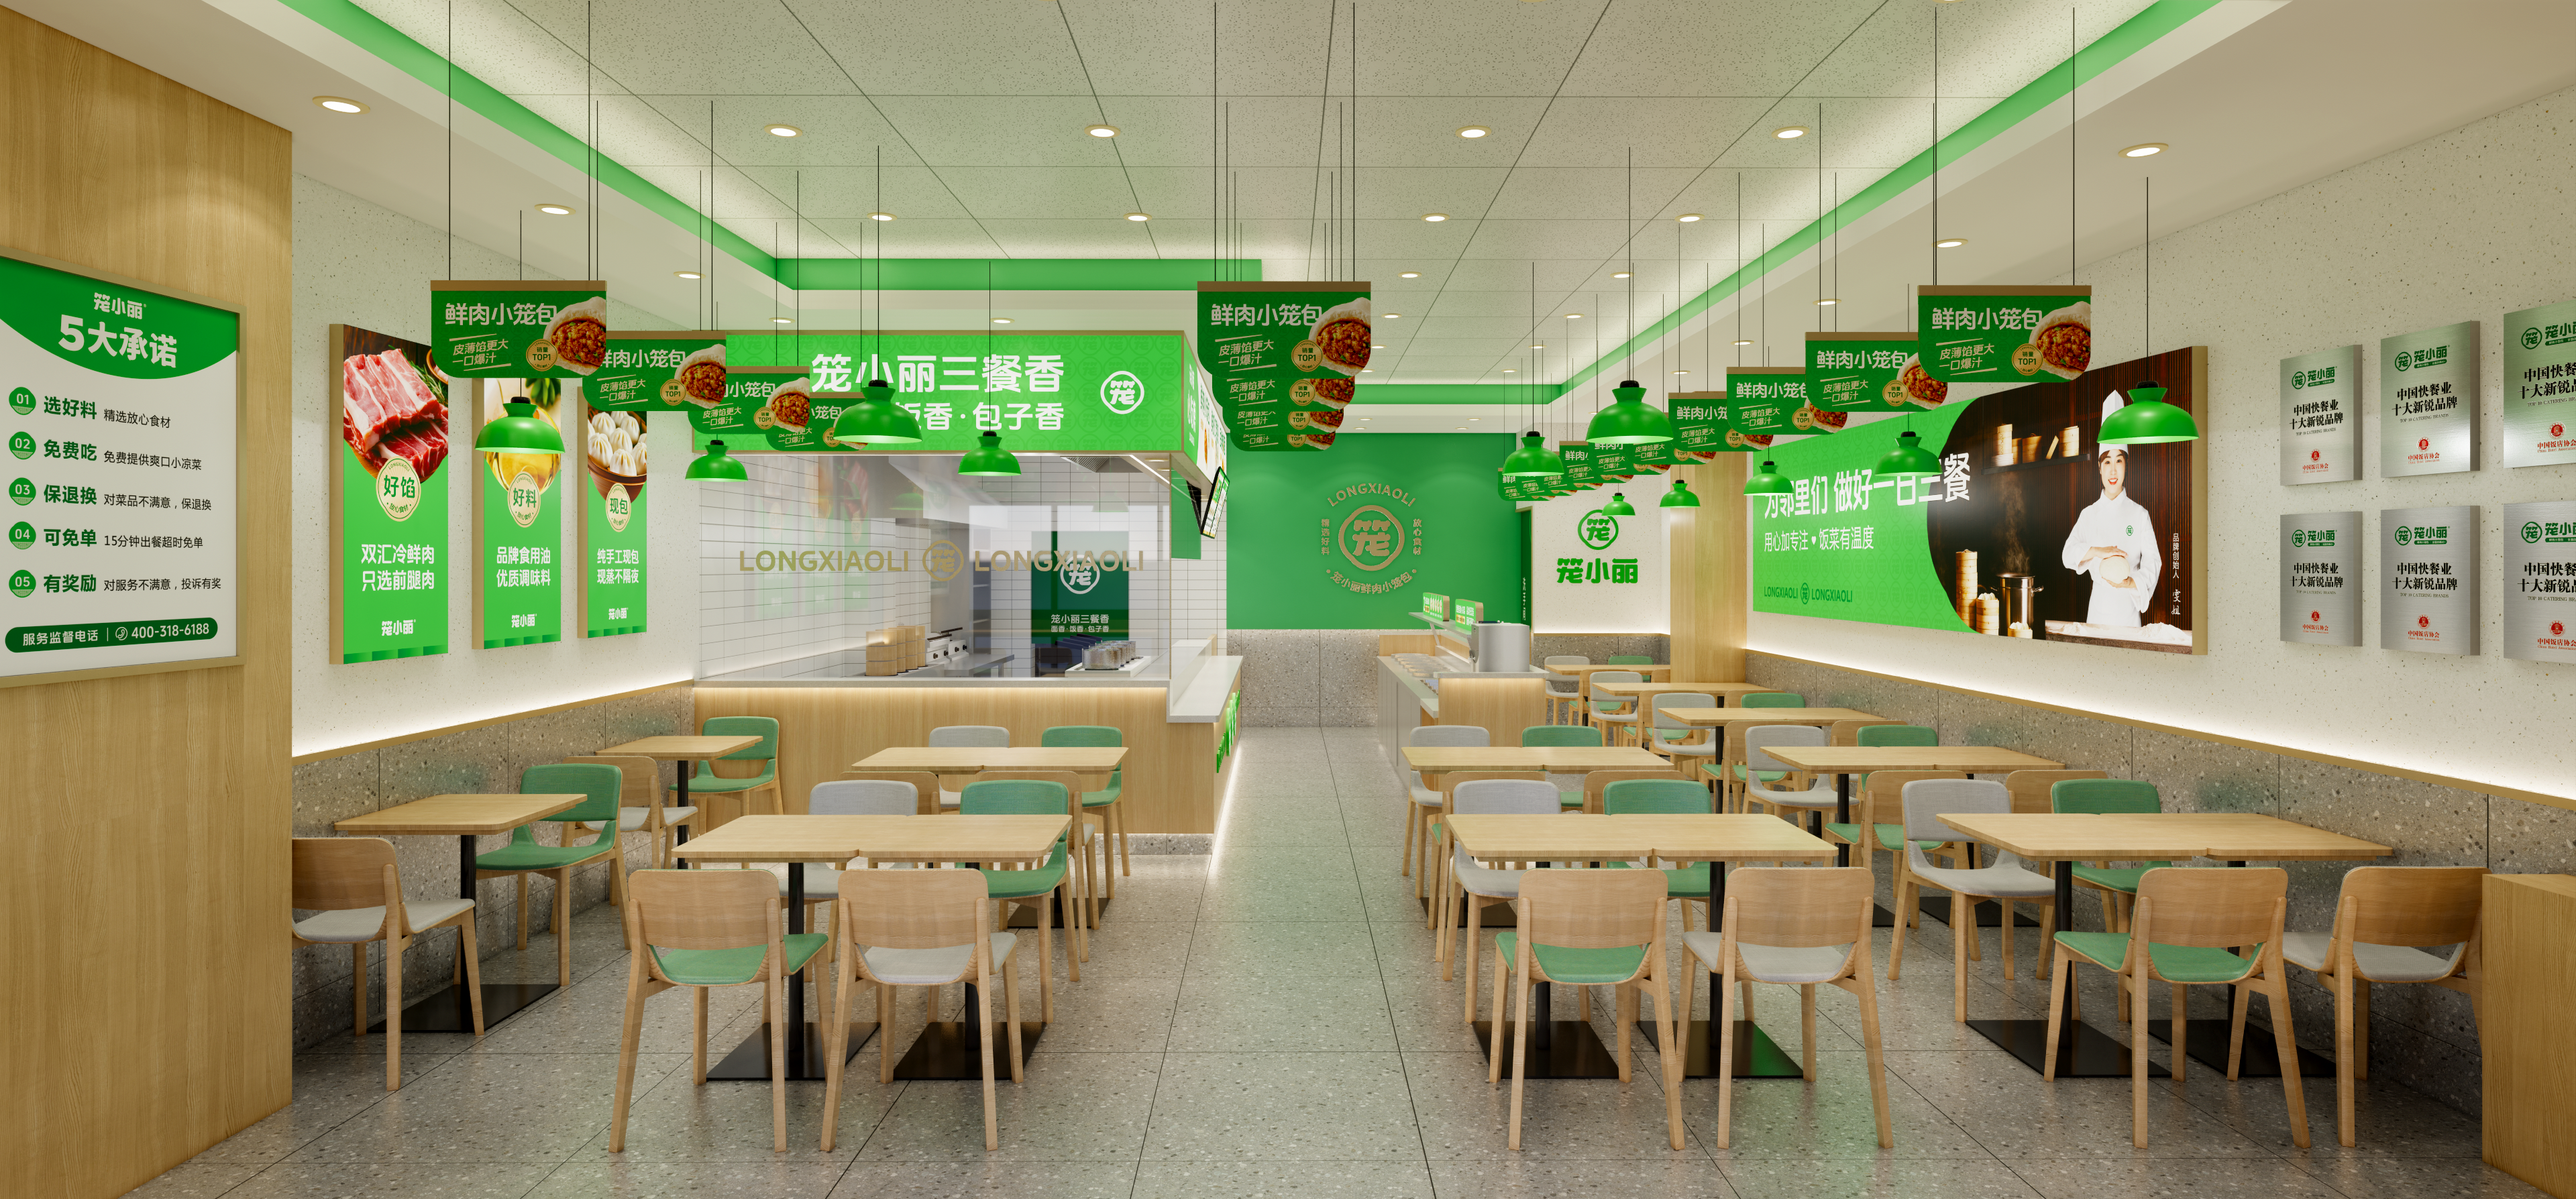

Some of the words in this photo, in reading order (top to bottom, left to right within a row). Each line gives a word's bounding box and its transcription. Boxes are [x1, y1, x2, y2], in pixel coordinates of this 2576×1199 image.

[94, 293, 143, 320] 笼小丽
[445, 302, 557, 326] 鲜肉小笼包
[1211, 304, 1322, 327] 鲜肉小笼包
[1932, 307, 2042, 330] 鲜肉小笼包
[2545, 321, 2576, 339] 笼小
[58, 315, 177, 368] 5大承诺
[453, 338, 508, 356] 皮薄馅更大
[1219, 339, 1275, 356] 皮薄馅更大
[1817, 350, 1909, 369] 鲜肉小笼包
[1939, 343, 1994, 360] 皮薄馅更大
[2414, 345, 2447, 363] 笼小丽
[452, 353, 496, 367] 一口爆汁
[1218, 353, 1262, 367] 一口爆汁
[1939, 357, 1983, 370] 一口爆汁
[811, 354, 1064, 393] 笼小丽三餐香
[2308, 367, 2335, 382] 笼小丽
[600, 379, 646, 393] 皮薄馅更大
[1230, 380, 1275, 393] 皮薄馅更大
[1823, 380, 1869, 394] 皮薄馅更大
[2397, 382, 2452, 401] 中国快餐业
[16, 393, 30, 405] 01
[600, 390, 635, 402] 一口爆汁
[1230, 391, 1265, 402] 一口爆汁
[1823, 390, 1859, 402] 一口爆汁
[44, 396, 97, 419] 选好料
[103, 408, 171, 429] 精选放心食材
[703, 406, 741, 418] 皮薄馅更大
[1741, 407, 1780, 419] 皮薄馅更大
[2294, 399, 2339, 416] 中国快餐业
[2392, 396, 2457, 416] 十大新锐品牌
[702, 416, 733, 426] 一口爆汁
[1237, 416, 1268, 426] 一口爆汁
[1741, 416, 1772, 426] 一口爆汁
[2289, 412, 2343, 429] 十大新锐品牌
[778, 435, 805, 444] 一口爆汁
[1243, 435, 1269, 444] 一口爆汁
[1680, 436, 1708, 445] 一口爆汁
[1681, 428, 1715, 439] 皮薄馅更大
[15, 438, 30, 449] 02
[1635, 444, 1665, 453] 皮薄馅更大
[2537, 439, 2576, 449] 中国饭店协会
[44, 439, 97, 461] 免费吃
[103, 450, 202, 471] 免费提供爽口小凉菜
[2408, 452, 2440, 461] 中国饭店协会
[15, 484, 30, 495] 03
[44, 484, 97, 505] 保退换
[384, 475, 415, 498] 好馅
[513, 488, 537, 508] 好料
[1328, 483, 1416, 507] LONGXIAOLI
[610, 498, 628, 514] 现包
[15, 528, 30, 539] 04
[1321, 518, 1330, 555] 精选好料
[1413, 518, 1422, 555] 放心食材
[2308, 530, 2335, 541] 笼小丽
[2414, 526, 2447, 538] 笼小丽
[2545, 522, 2576, 536] 笼小
[44, 528, 97, 547] 可免单
[103, 534, 203, 549] 15分钟出餐超时免单
[1352, 520, 1391, 557] 笼
[1764, 529, 1809, 552] 用心加专注
[1819, 525, 1874, 551] 饭菜有温度
[361, 543, 435, 566] 双汇冷鲜肉
[496, 547, 551, 565] 品牌食用油
[597, 549, 639, 565] 纯手工现包
[739, 551, 908, 571] LONGXIAOLI
[975, 551, 1144, 571] LONGXIAOLI
[597, 568, 639, 585] 现蒸不隔夜
[1556, 558, 1638, 584] 笼小丽
[2294, 563, 2339, 574] 中国快餐业
[2397, 563, 2452, 575] 中国快餐业
[15, 576, 30, 587] 05
[44, 574, 97, 593] 有奖励
[362, 569, 435, 592] 只选前腿肉
[496, 569, 551, 588] 优质调味料
[1330, 571, 1413, 594] 笼小丽鲜肉小笼包
[2290, 576, 2343, 588] 十大新锐品牌
[2392, 577, 2457, 590] 十大新锐品牌
[1764, 586, 1798, 599] LONGXIAOLI
[1812, 589, 1853, 602] LONGXIAOLI
[511, 614, 536, 628] 笼小丽
[608, 608, 628, 620] 笼小丽
[1051, 614, 1109, 624] 笼小丽三餐香
[22, 628, 99, 646] 服务监督电话
[131, 622, 210, 640] 400-318-6188
[381, 619, 413, 636] 笼小丽
[2408, 630, 2440, 638] 中国饭店协会
[2537, 638, 2576, 646] 中国饭店协会
